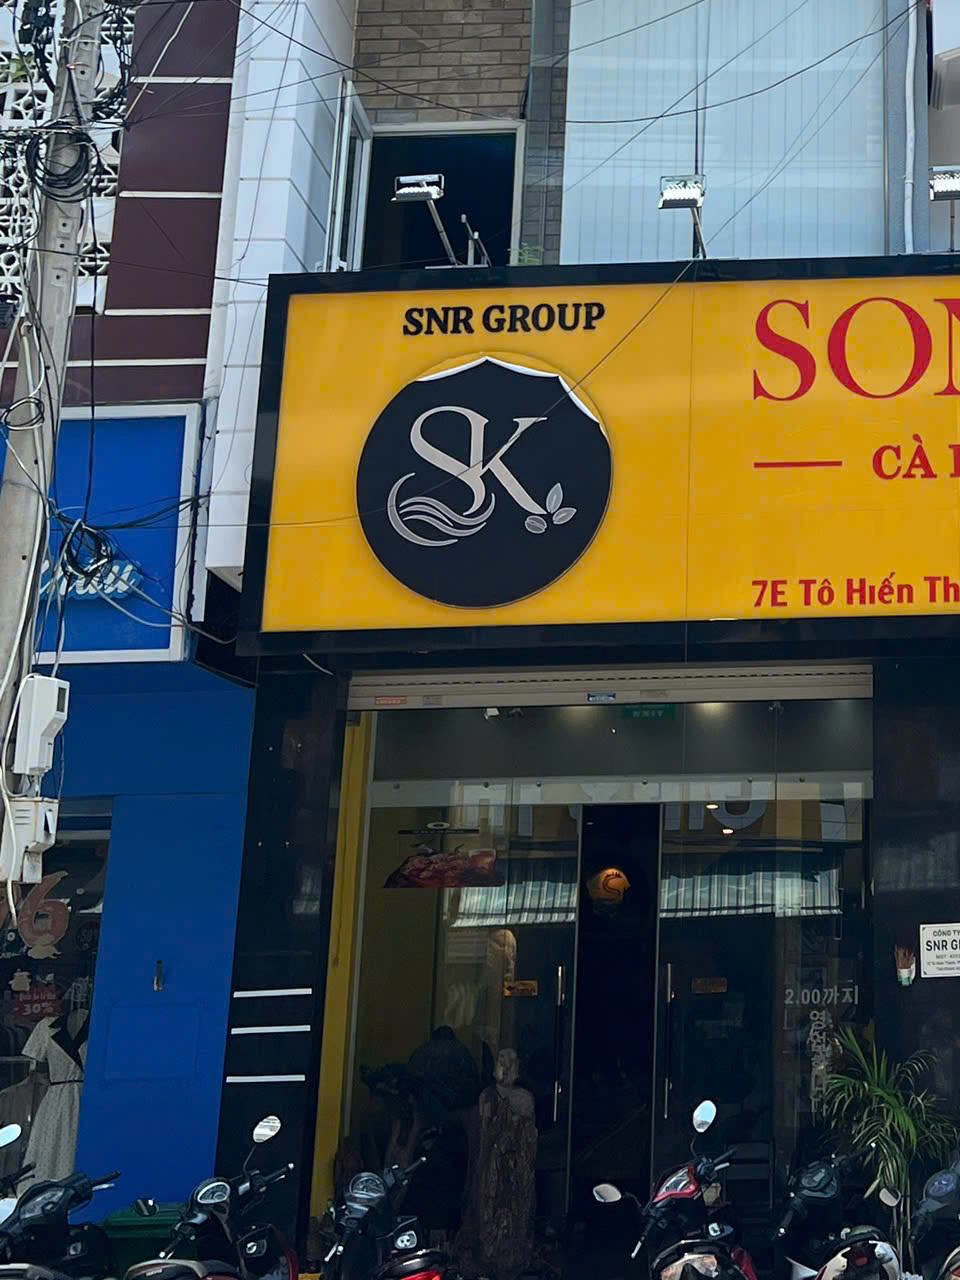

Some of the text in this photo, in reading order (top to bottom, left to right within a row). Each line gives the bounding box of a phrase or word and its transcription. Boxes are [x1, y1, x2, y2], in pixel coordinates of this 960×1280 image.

[402, 301, 606, 336] SNR GROUP
[872, 433, 938, 480] CÀ
[751, 578, 788, 608] 7E
[799, 577, 835, 607] Tô
[926, 939, 948, 951] SNR
[932, 929, 952, 937] CÔNG
